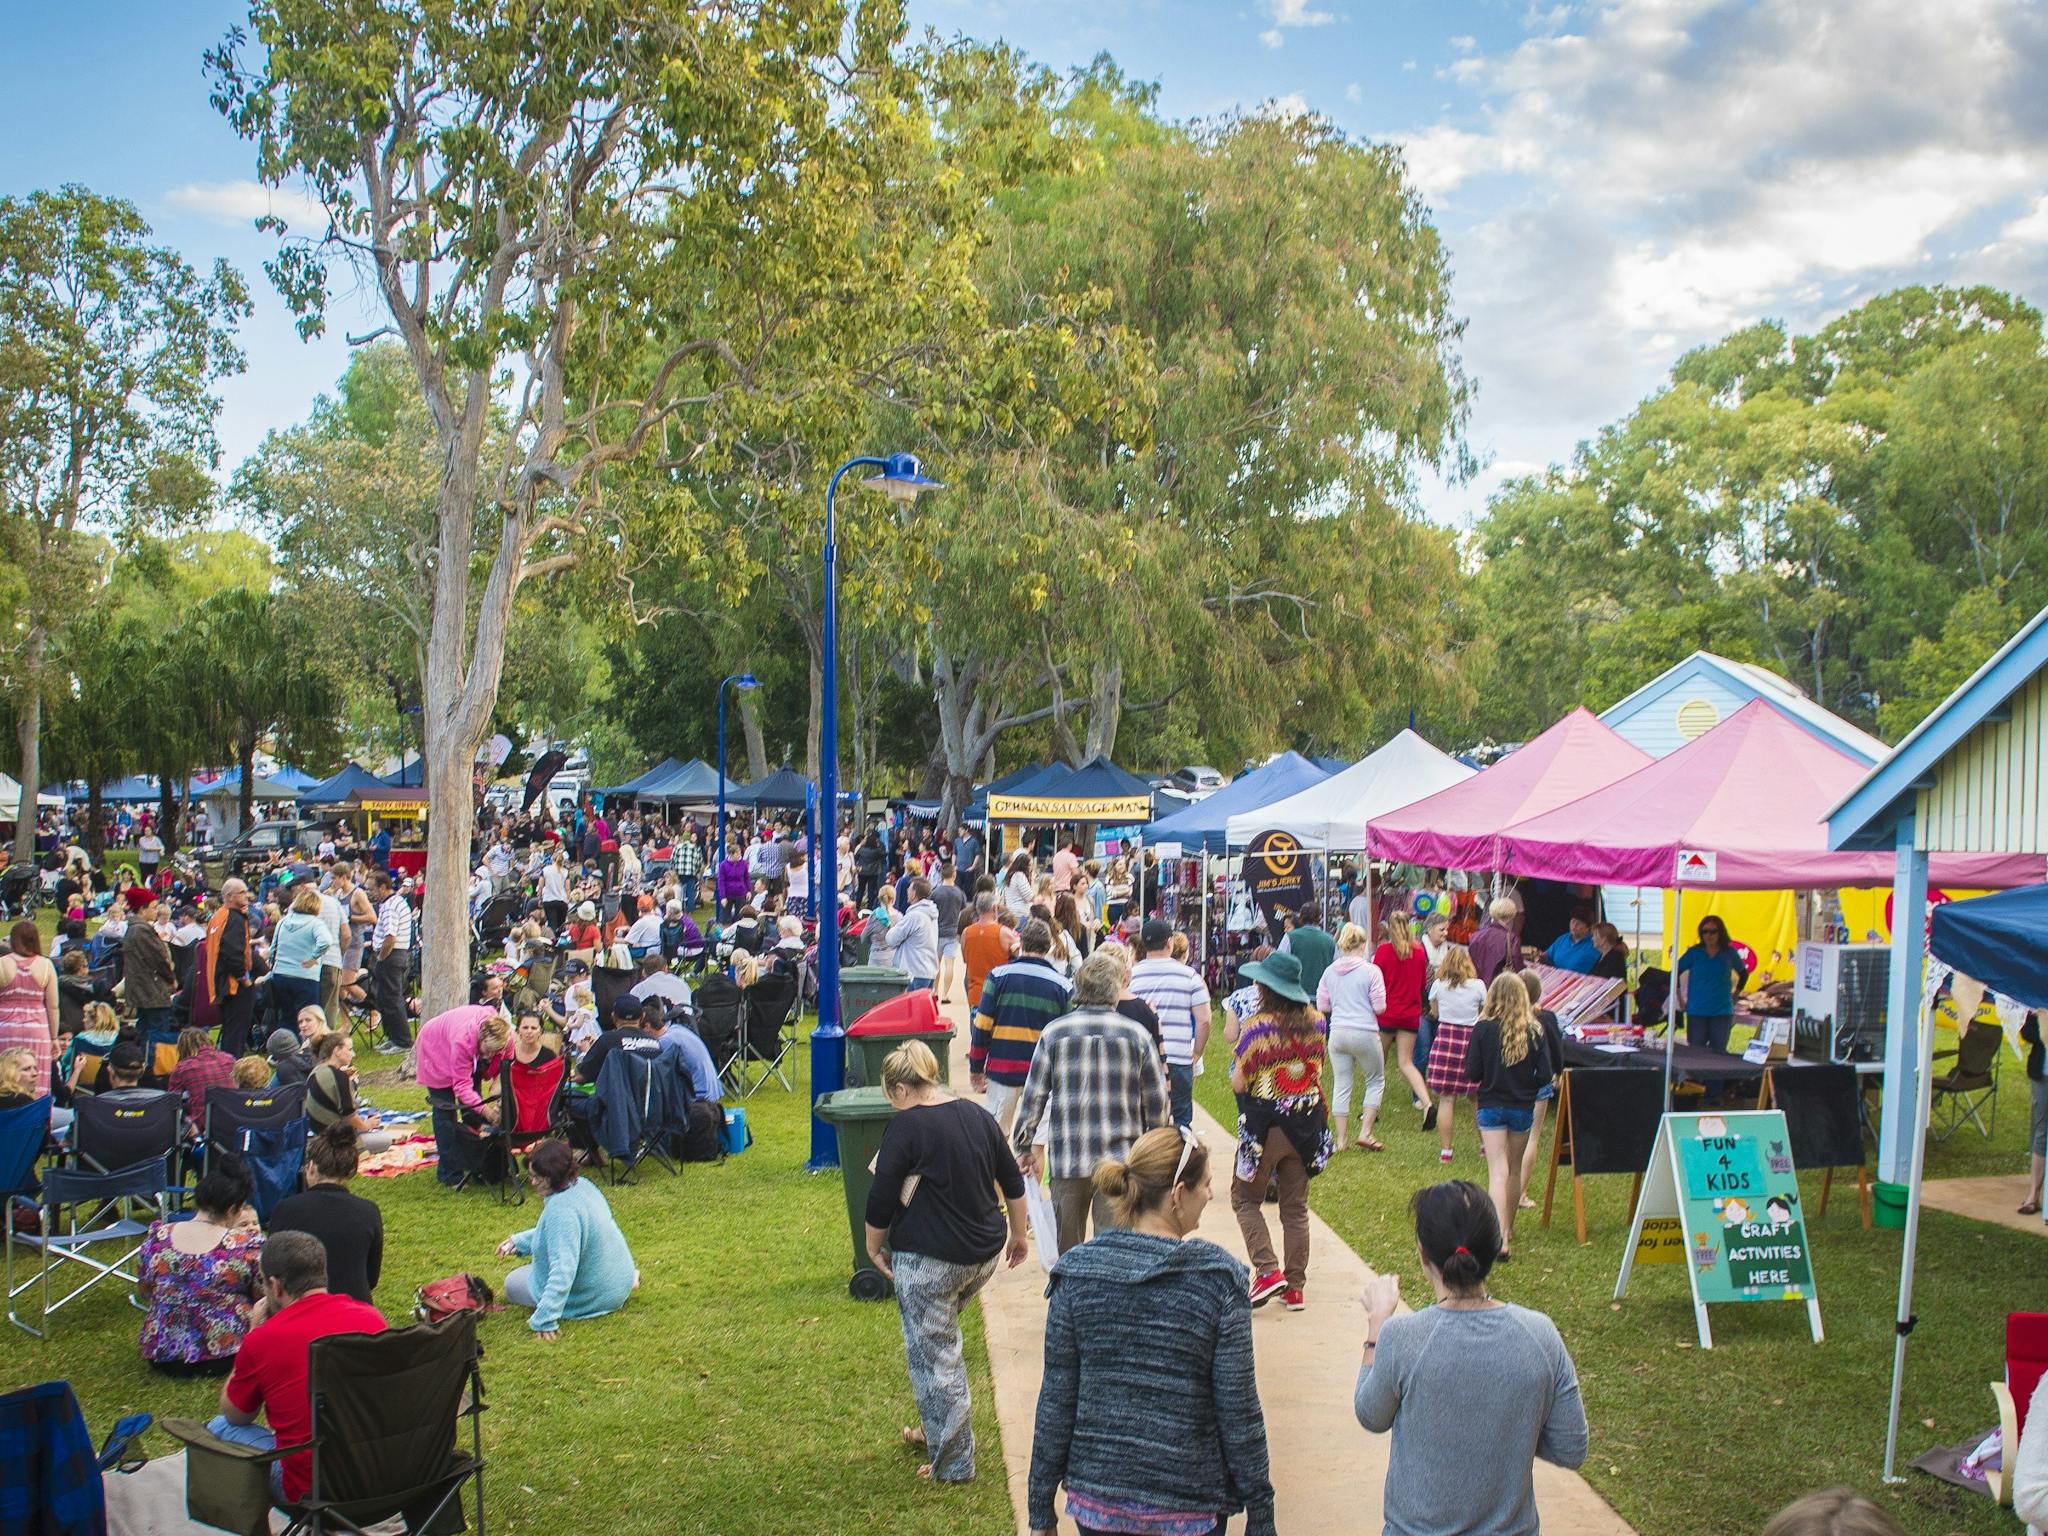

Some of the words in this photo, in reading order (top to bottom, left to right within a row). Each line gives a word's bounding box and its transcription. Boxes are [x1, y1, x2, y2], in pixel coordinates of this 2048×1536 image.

[995, 801, 1050, 813] GERMAN
[1051, 802, 1110, 814] SAUSAGE
[1113, 802, 1143, 813] MAN
[1257, 878, 1278, 889] JIM'S
[1278, 875, 1302, 887] JERKY
[1703, 1138, 1736, 1152] FUN
[1719, 1154, 1731, 1170] 4
[1706, 1172, 1750, 1191] KIDS
[1741, 1221, 1792, 1238] CRAFT
[1728, 1245, 1801, 1261] ACTIVITIES
[1748, 1269, 1790, 1284] HERE
